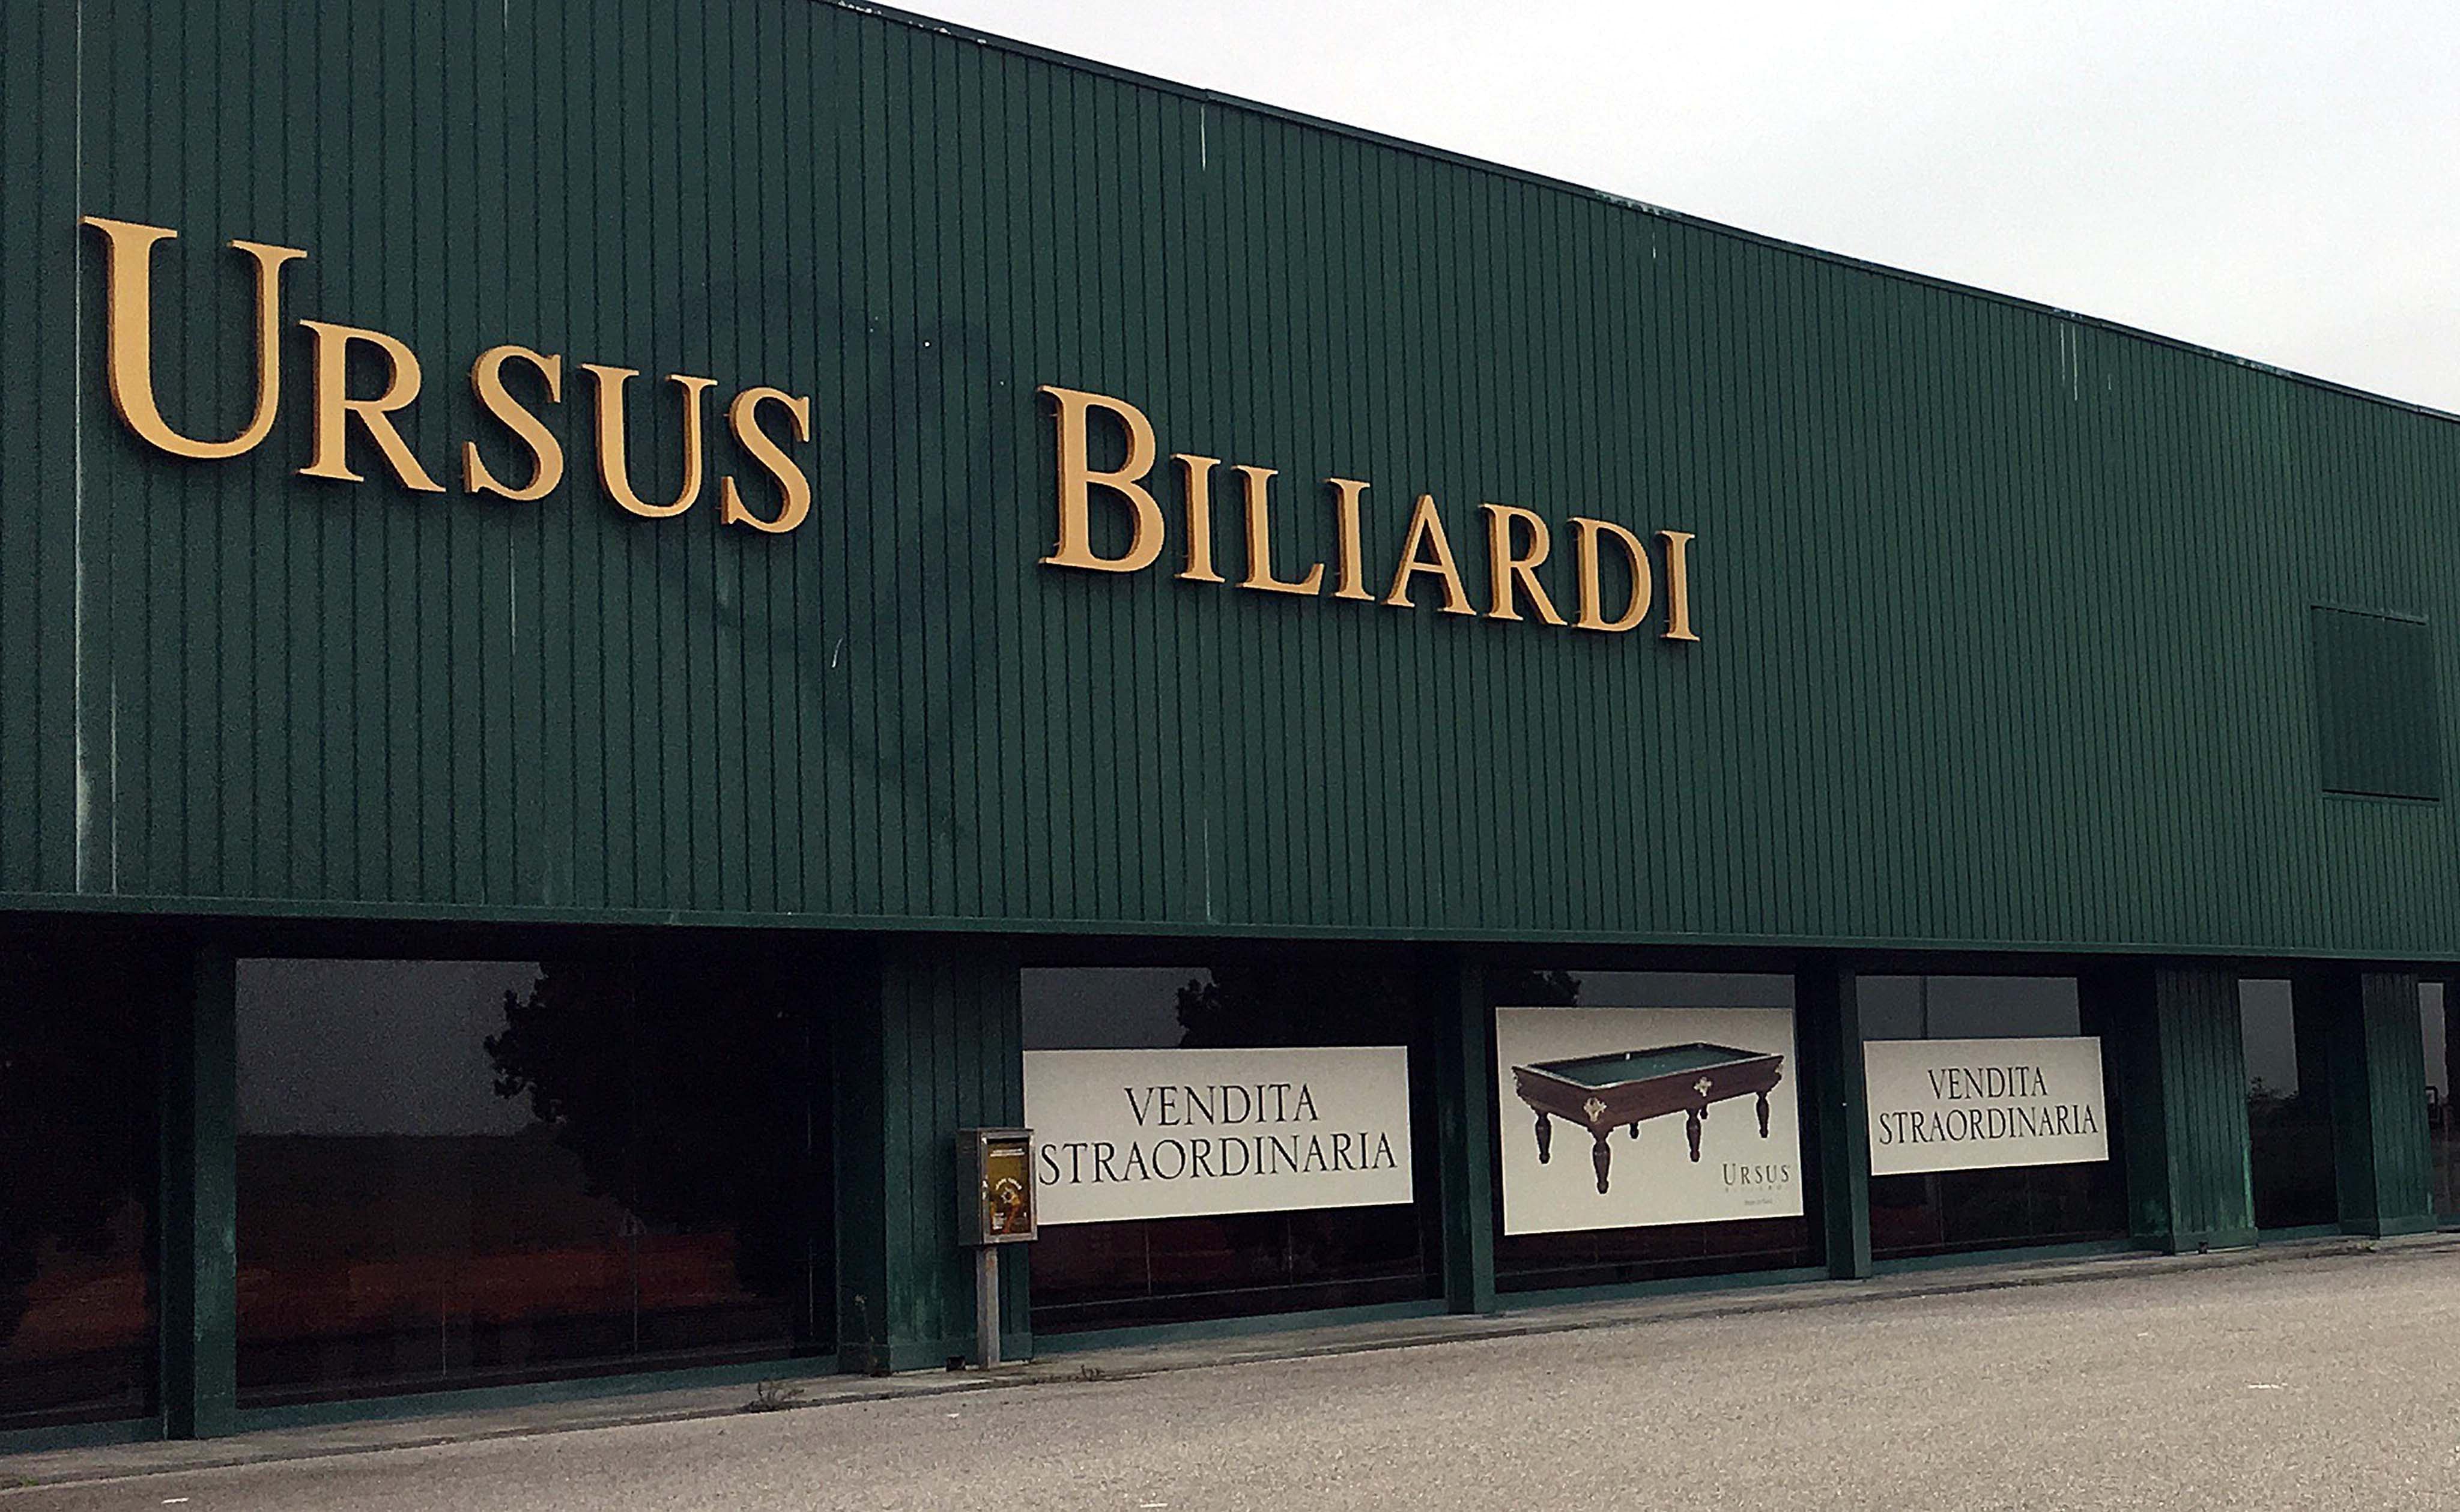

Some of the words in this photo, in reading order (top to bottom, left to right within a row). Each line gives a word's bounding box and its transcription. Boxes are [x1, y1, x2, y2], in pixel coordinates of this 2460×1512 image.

[78, 216, 811, 534] URSUS
[1037, 385, 1699, 641] BILIARDI
[1927, 1066, 2047, 1099] VENDITA
[1125, 1083, 1319, 1126] VENDITA
[1879, 1104, 2098, 1145] STRAORDINARIA
[1038, 1132, 1398, 1185] STRAORDINARIA
[1722, 1163, 1789, 1186] URSUS
